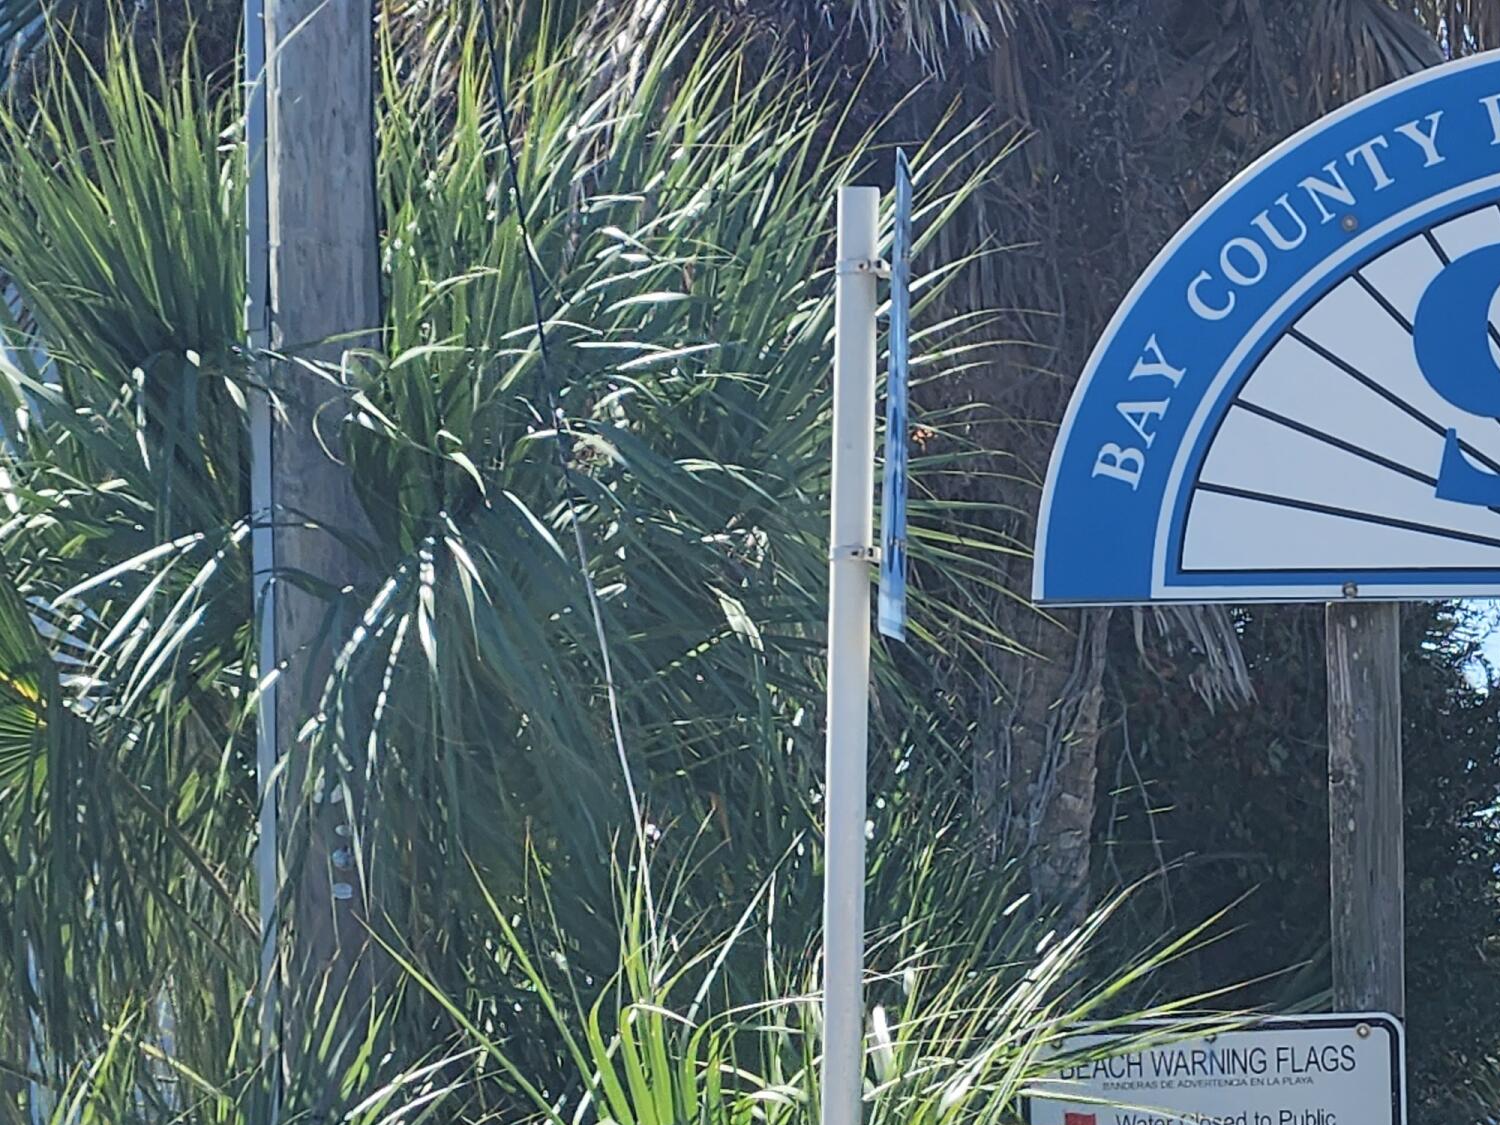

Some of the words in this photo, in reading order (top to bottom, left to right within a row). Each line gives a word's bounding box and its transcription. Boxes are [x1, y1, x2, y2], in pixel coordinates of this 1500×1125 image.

[1091, 333, 1187, 491] BAY
[1187, 110, 1446, 320] COUNTY
[1152, 1047, 1267, 1077] WARNING
[1276, 1045, 1356, 1073] FLAGS
[1161, 1080, 1174, 1090] DE
[1250, 1078, 1264, 1087] EN
[1267, 1077, 1280, 1086] LA
[1282, 1076, 1313, 1086] PLAYA
